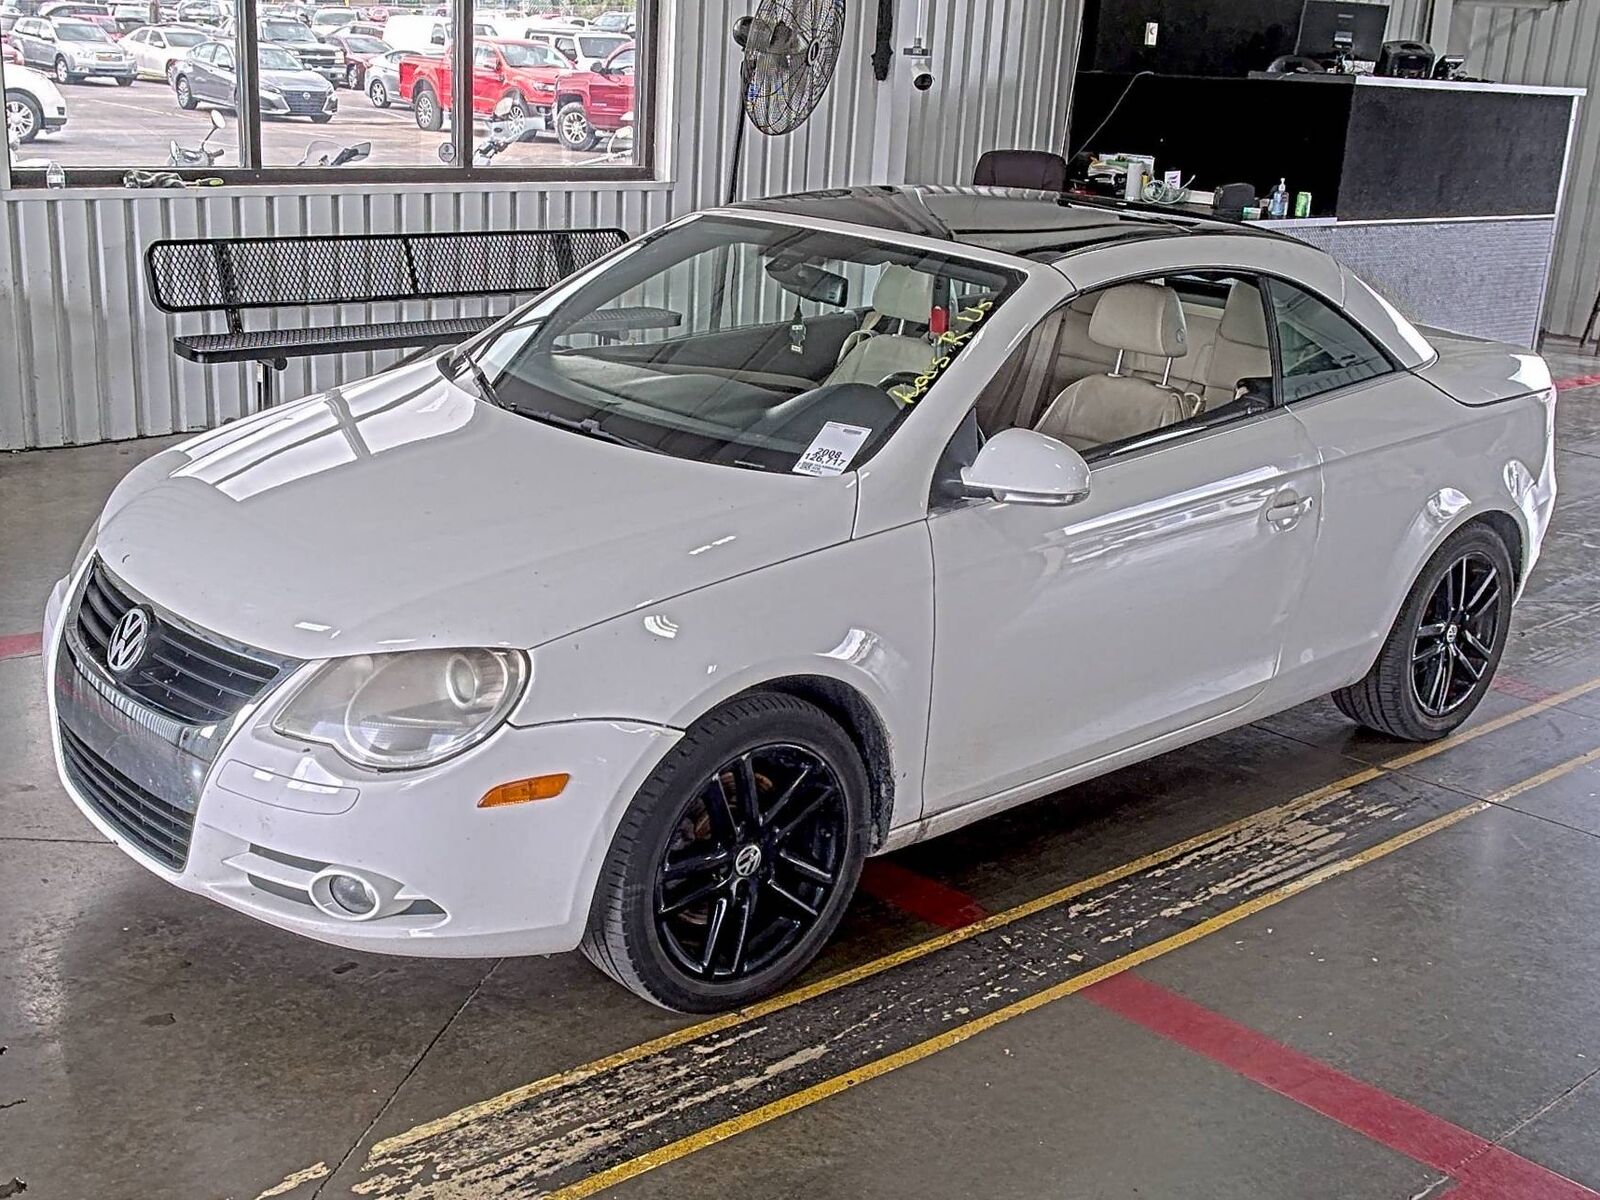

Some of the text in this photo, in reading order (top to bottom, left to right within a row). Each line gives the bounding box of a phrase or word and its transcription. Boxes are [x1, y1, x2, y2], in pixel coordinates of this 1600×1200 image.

[804, 452, 847, 467] 126,717
[814, 447, 843, 459] 2008
[107, 608, 148, 671] VW
[736, 845, 762, 877] VW
